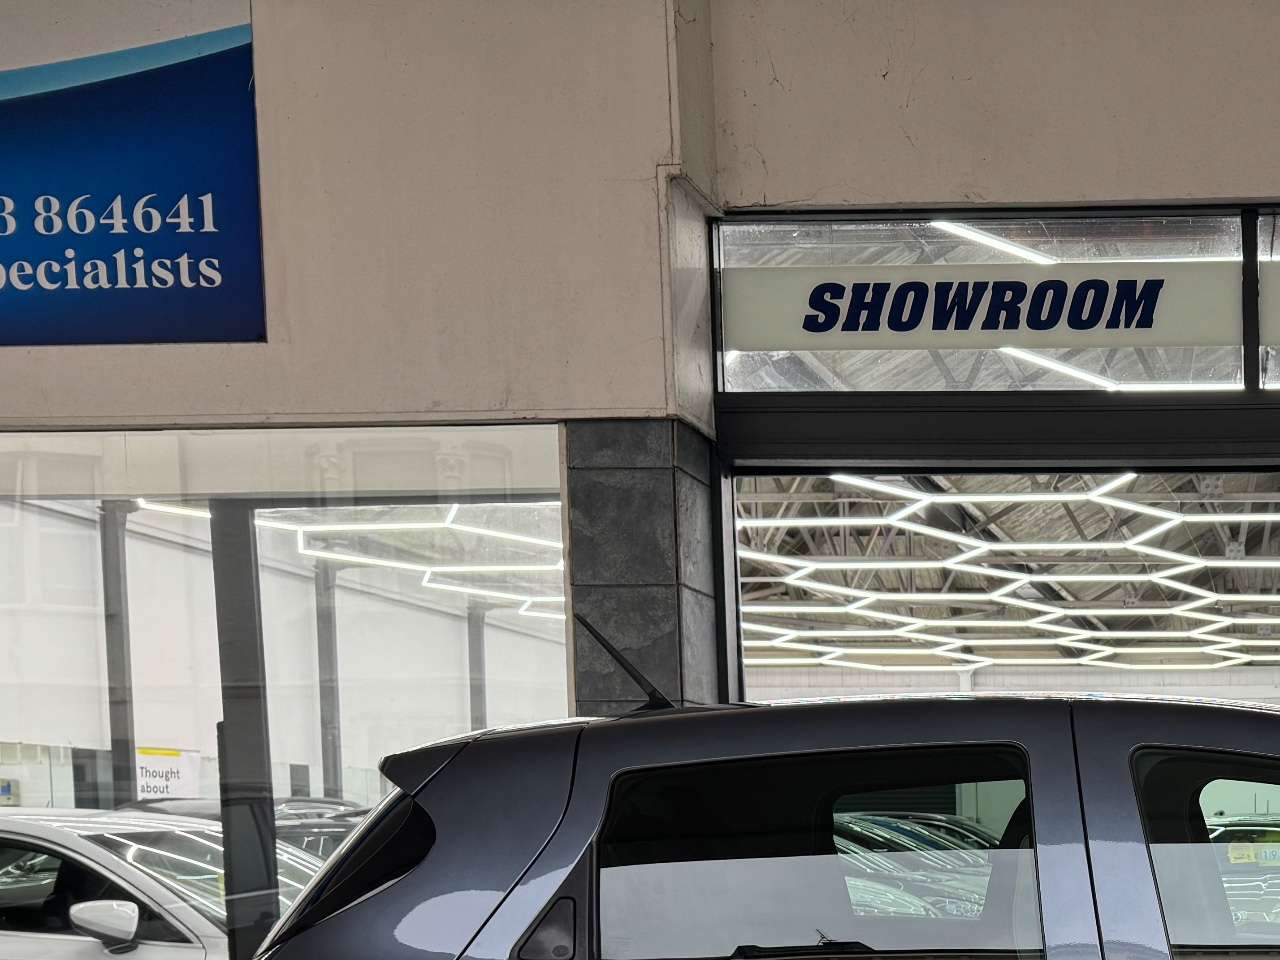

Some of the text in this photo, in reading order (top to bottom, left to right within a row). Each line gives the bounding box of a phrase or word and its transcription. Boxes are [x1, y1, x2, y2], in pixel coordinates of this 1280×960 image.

[34, 192, 219, 235] 864641
[0, 247, 223, 291] ecialists
[802, 278, 1165, 333] SHOWROOM
[139, 766, 181, 781] Thought
[140, 782, 170, 794] about
